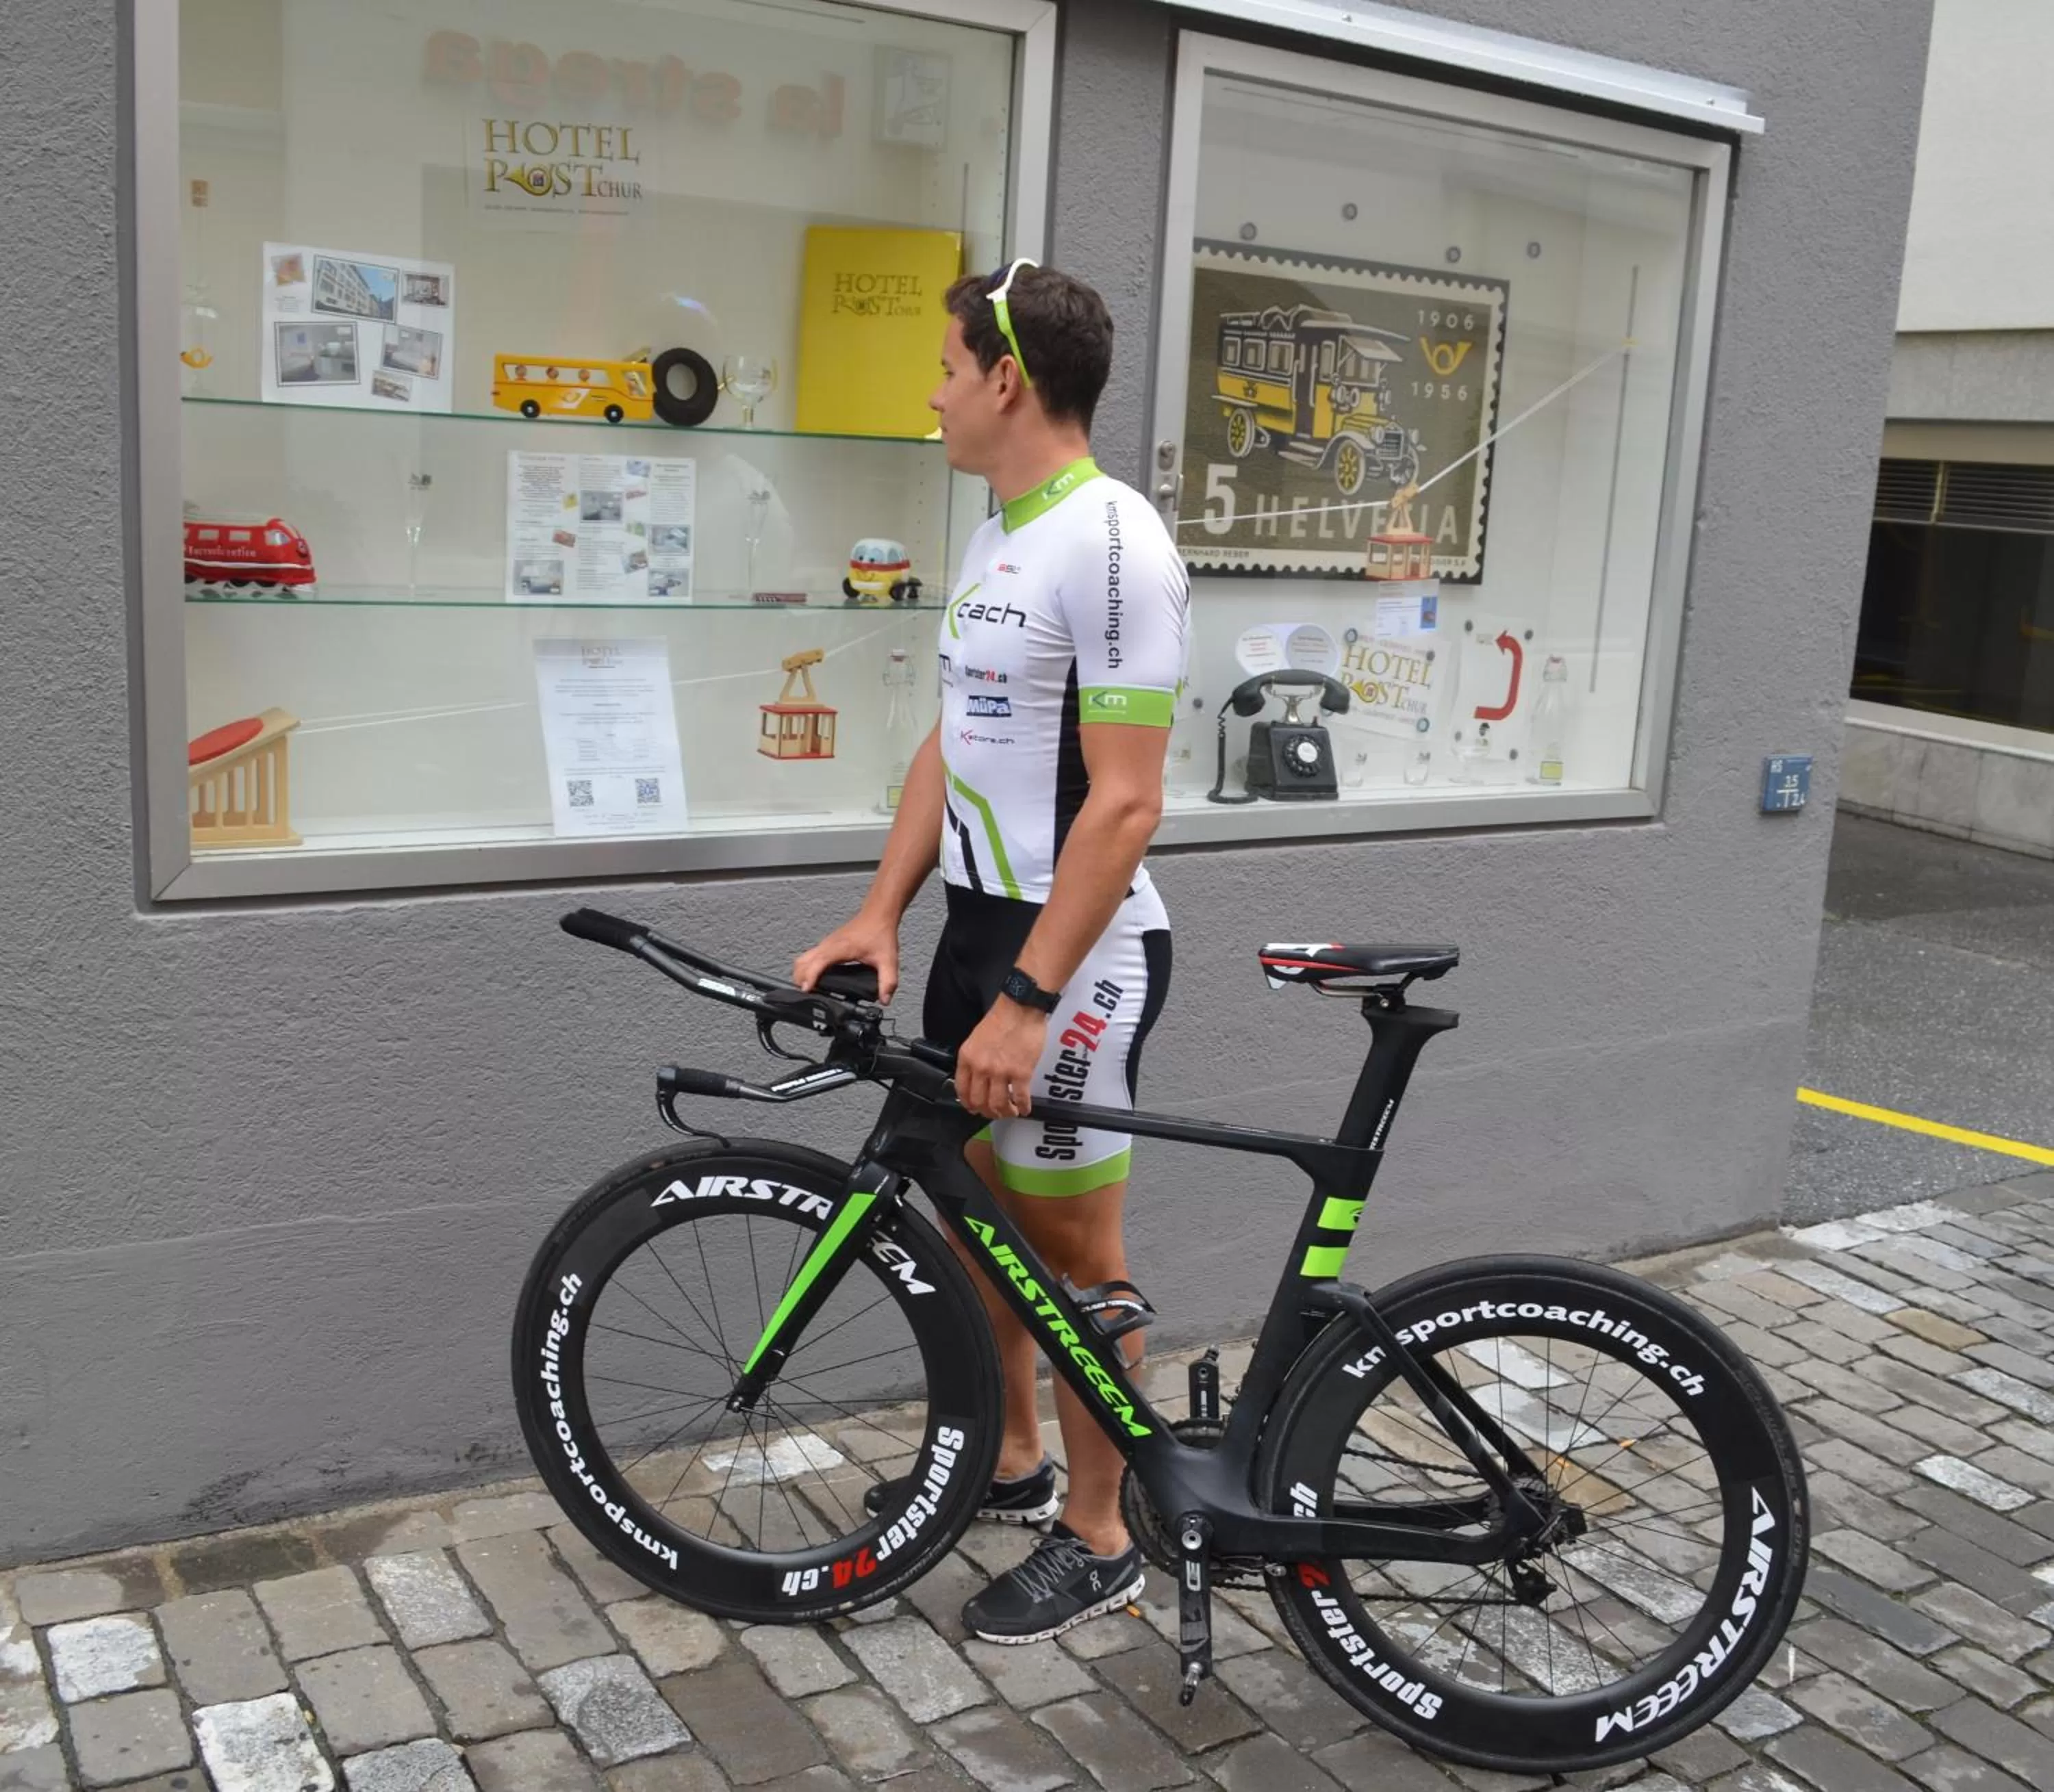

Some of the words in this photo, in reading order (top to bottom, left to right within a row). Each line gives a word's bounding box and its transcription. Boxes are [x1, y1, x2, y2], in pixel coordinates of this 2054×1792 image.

[483, 118, 641, 165] HOTEL
[833, 272, 923, 296] HOTEL
[1417, 309, 1475, 331] 1906
[1411, 382, 1468, 401] 1956
[1204, 463, 1238, 535] 5
[1254, 493, 1458, 545] HELVEIA
[1104, 500, 1124, 669] kmsportcoaching.ch
[1342, 643, 1432, 689] HOTEL
[1035, 979, 1125, 1161] Sposter24.ch
[650, 1175, 937, 1296] AIRSTREM
[963, 1216, 1154, 1437] AIRSTREEEM
[540, 1272, 679, 1570] kmsportcoaching.ch
[781, 1424, 965, 1597] Sportster24.ch
[1594, 1485, 1777, 1743] AIRSTREEEM
